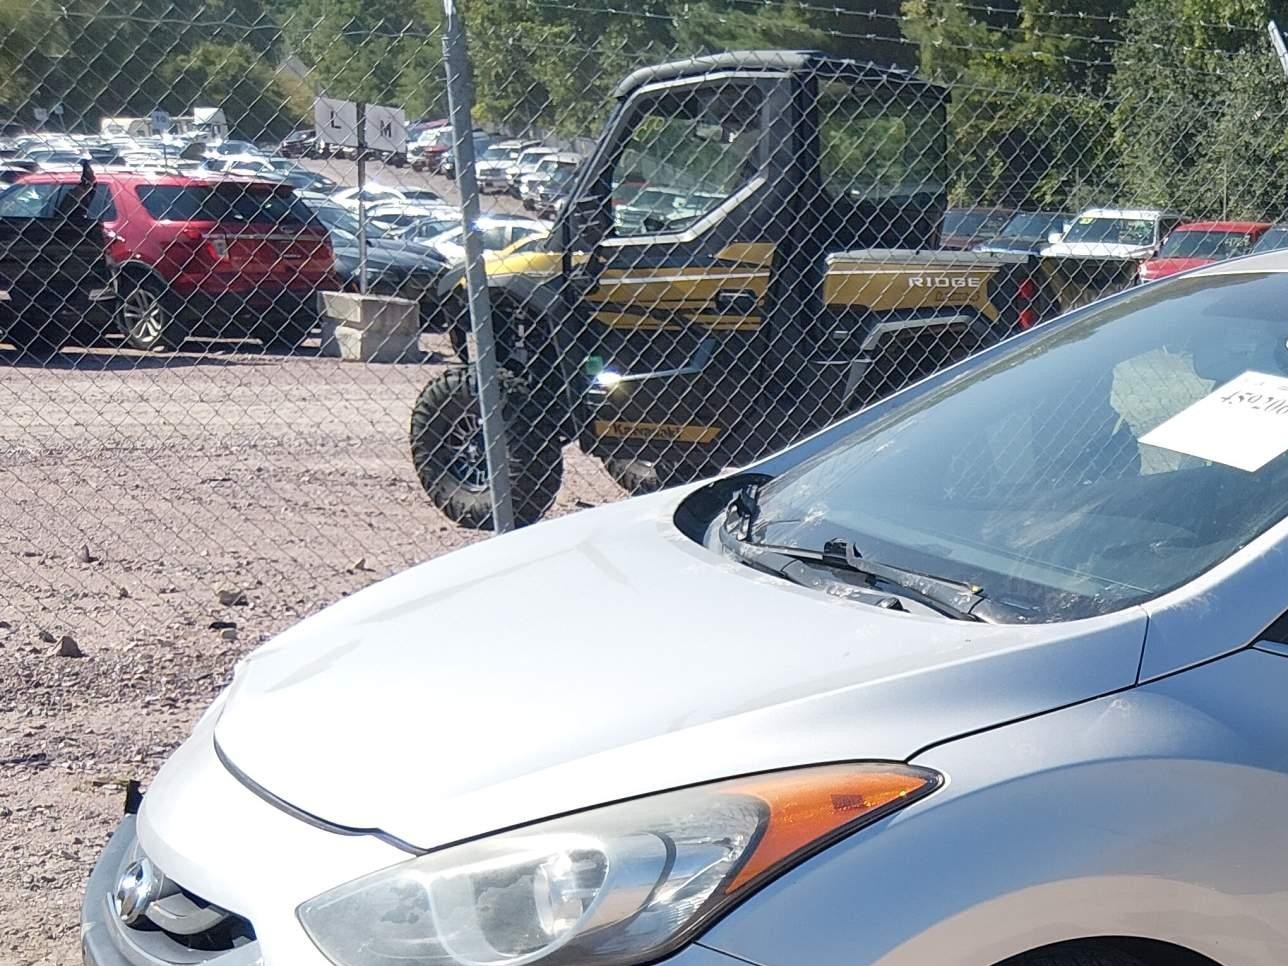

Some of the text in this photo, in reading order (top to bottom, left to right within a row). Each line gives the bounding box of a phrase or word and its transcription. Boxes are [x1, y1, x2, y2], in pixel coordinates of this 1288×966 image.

[330, 110, 342, 129] L
[379, 120, 392, 138] M
[908, 277, 980, 288] RIDGE
